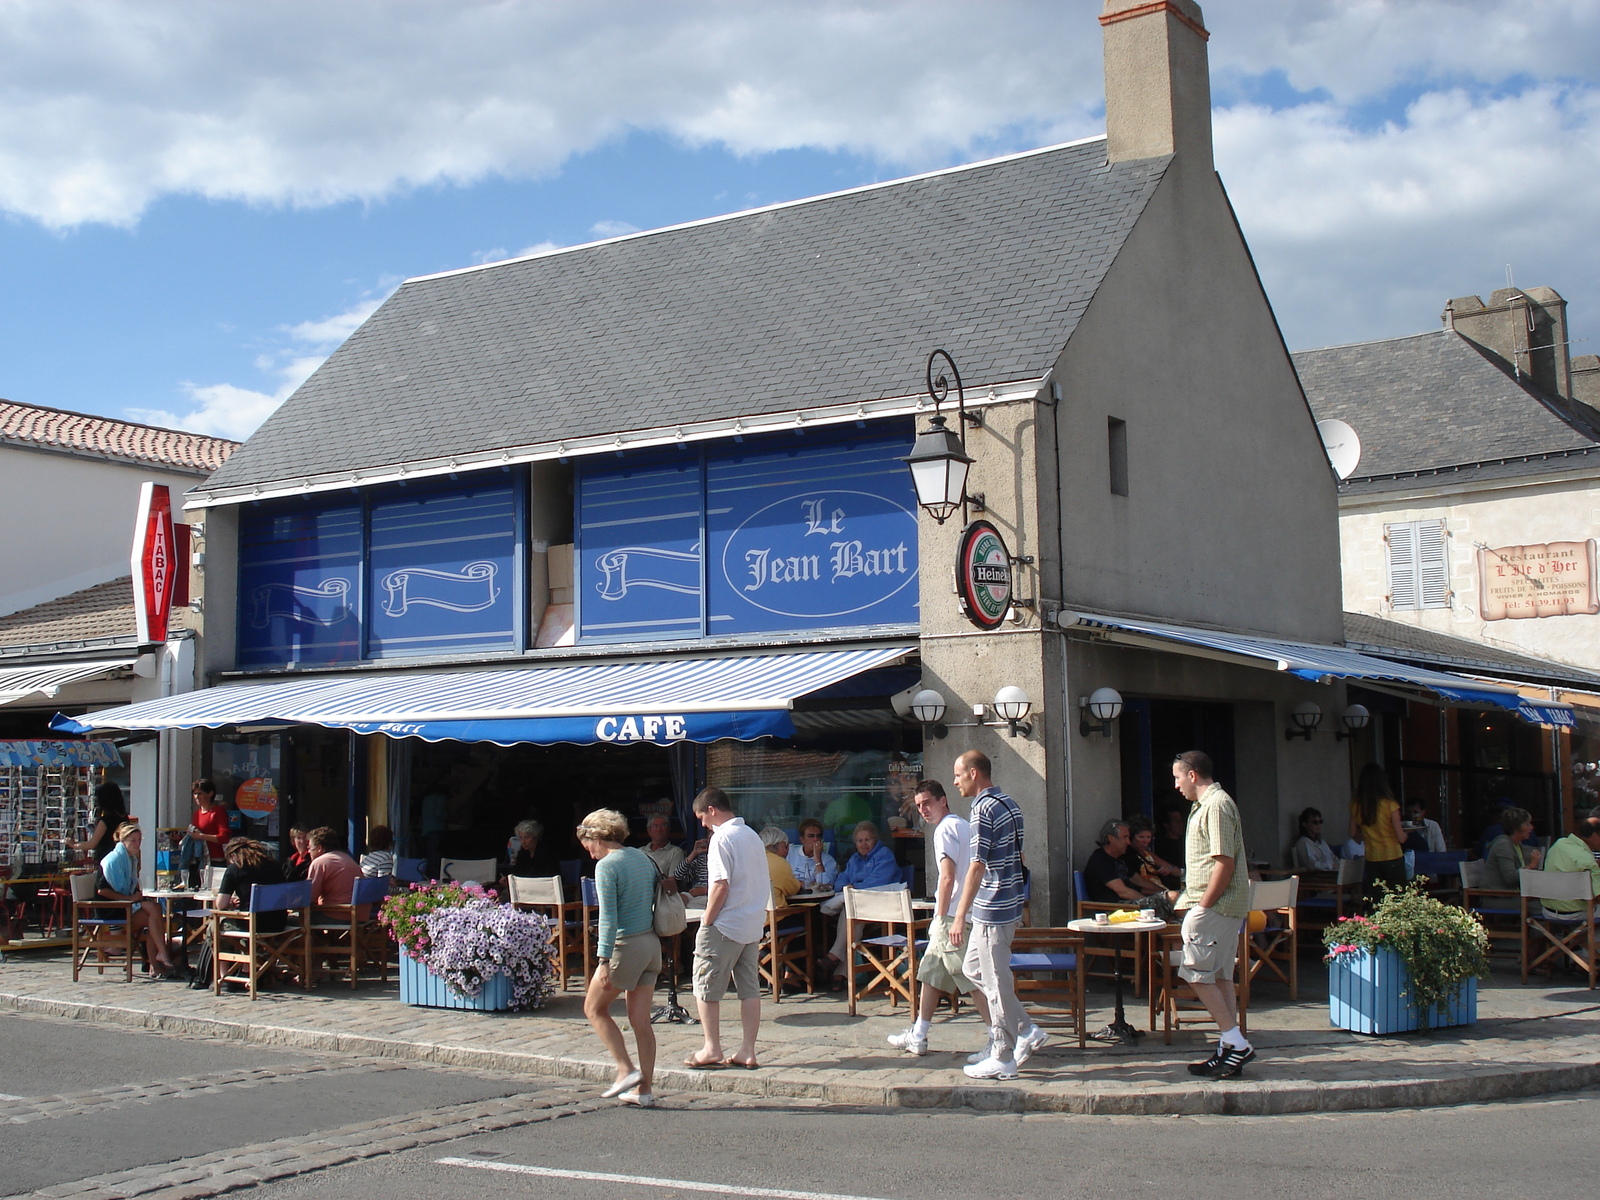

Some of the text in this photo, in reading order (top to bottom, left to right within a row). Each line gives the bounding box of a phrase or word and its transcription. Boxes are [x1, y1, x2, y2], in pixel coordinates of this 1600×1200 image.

[801, 499, 846, 537] Le
[155, 533, 165, 593] TABAC
[1500, 550, 1574, 562] Restaurant
[744, 540, 908, 591] Jean Bart
[1490, 586, 1515, 595] FRUITS
[1517, 585, 1527, 593] DE
[1552, 581, 1587, 590] POISSONS
[1537, 589, 1580, 597] HOMARDS
[1525, 597, 1575, 608] 51.39.11.93
[1545, 708, 1574, 725] TABAC
[596, 715, 687, 742] CAFE
